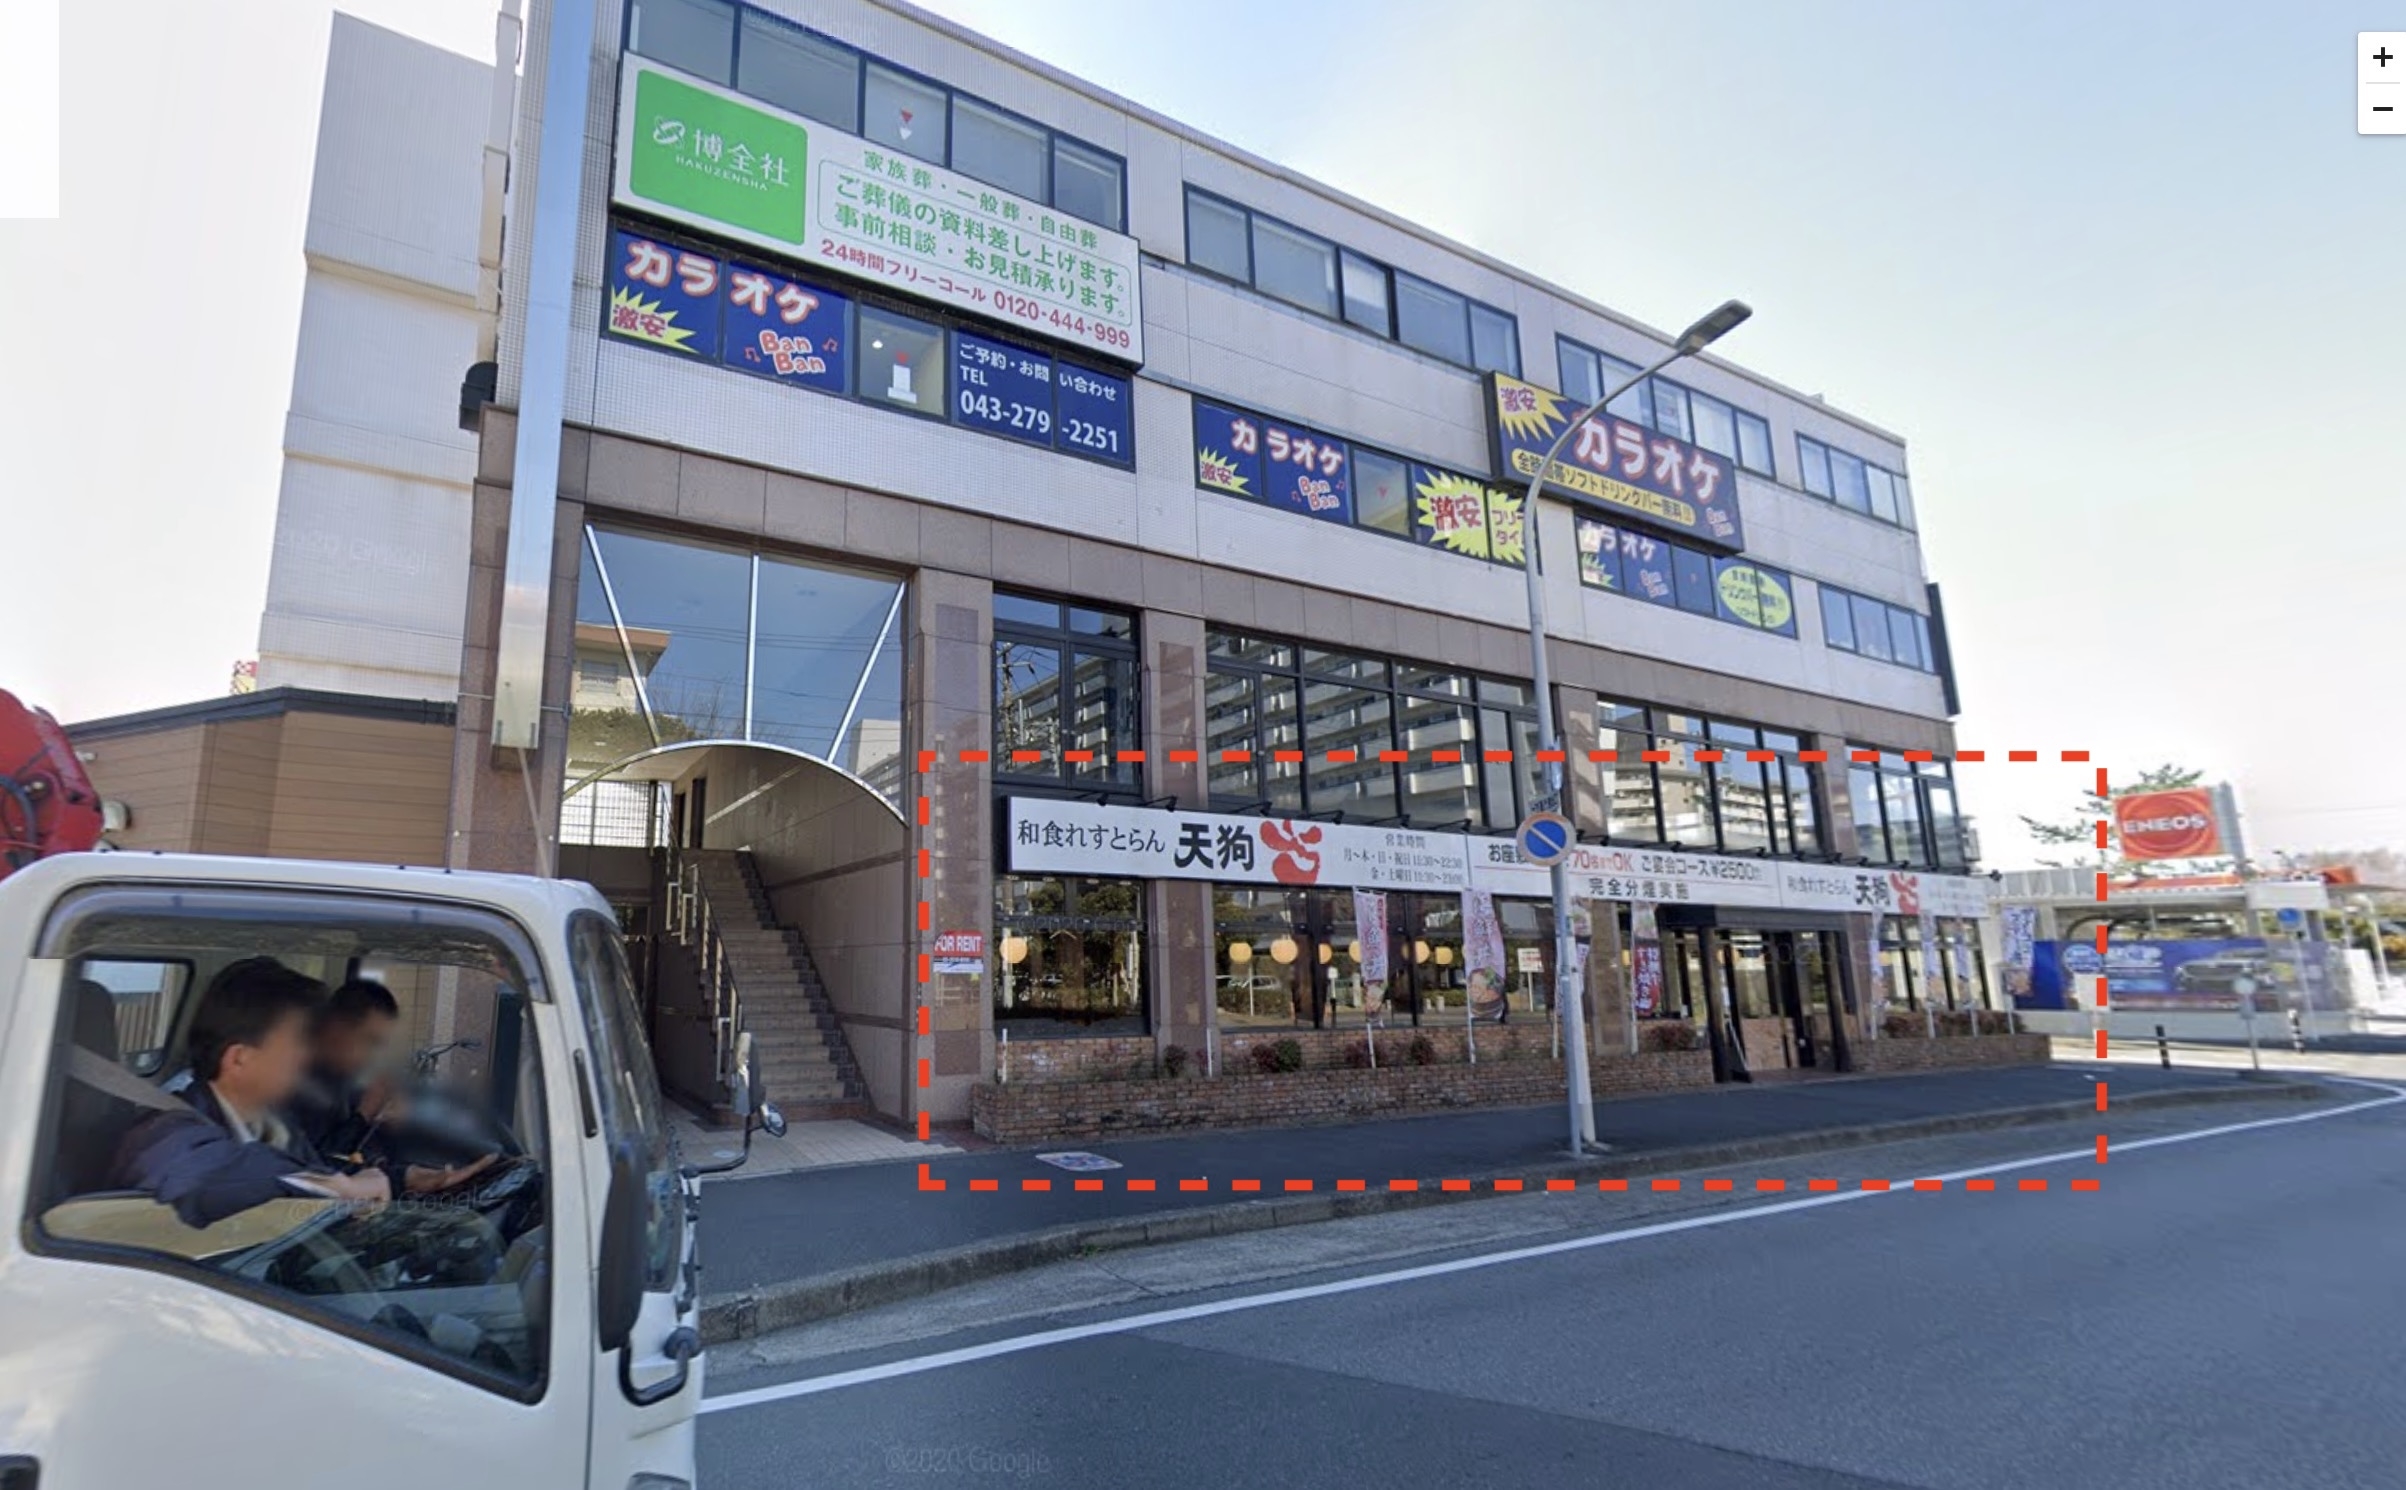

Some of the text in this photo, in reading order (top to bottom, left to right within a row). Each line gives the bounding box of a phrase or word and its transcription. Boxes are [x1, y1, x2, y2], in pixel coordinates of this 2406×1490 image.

[675, 154, 768, 191] HAKUZENSHA
[694, 128, 790, 187] 博全社
[863, 149, 1098, 249] 家族葬・一般葬・自由葬
[836, 173, 1125, 293] ご葬儀の資料差し上げます。
[834, 201, 1126, 318] 事前相談・お見積承ります。
[625, 241, 819, 324] カラオケ
[821, 238, 1131, 349] 24時間フリーコール 0120-444-999
[612, 302, 667, 338] 激安
[759, 329, 813, 354] Ban
[773, 350, 826, 375] Ban
[960, 365, 988, 387] TEL
[1500, 386, 1538, 412] 激安
[1230, 417, 1343, 475] カラオケ
[1200, 459, 1233, 486] 激安
[1298, 475, 1331, 495] Ban
[1308, 491, 1340, 511] Ban
[1430, 493, 1482, 532] 激安
[1495, 530, 1524, 545] タイ
[2122, 814, 2208, 834] ENEOS
[1017, 818, 1255, 872] 和食れすとらん 天狗
[934, 935, 982, 952] FOR RENT
